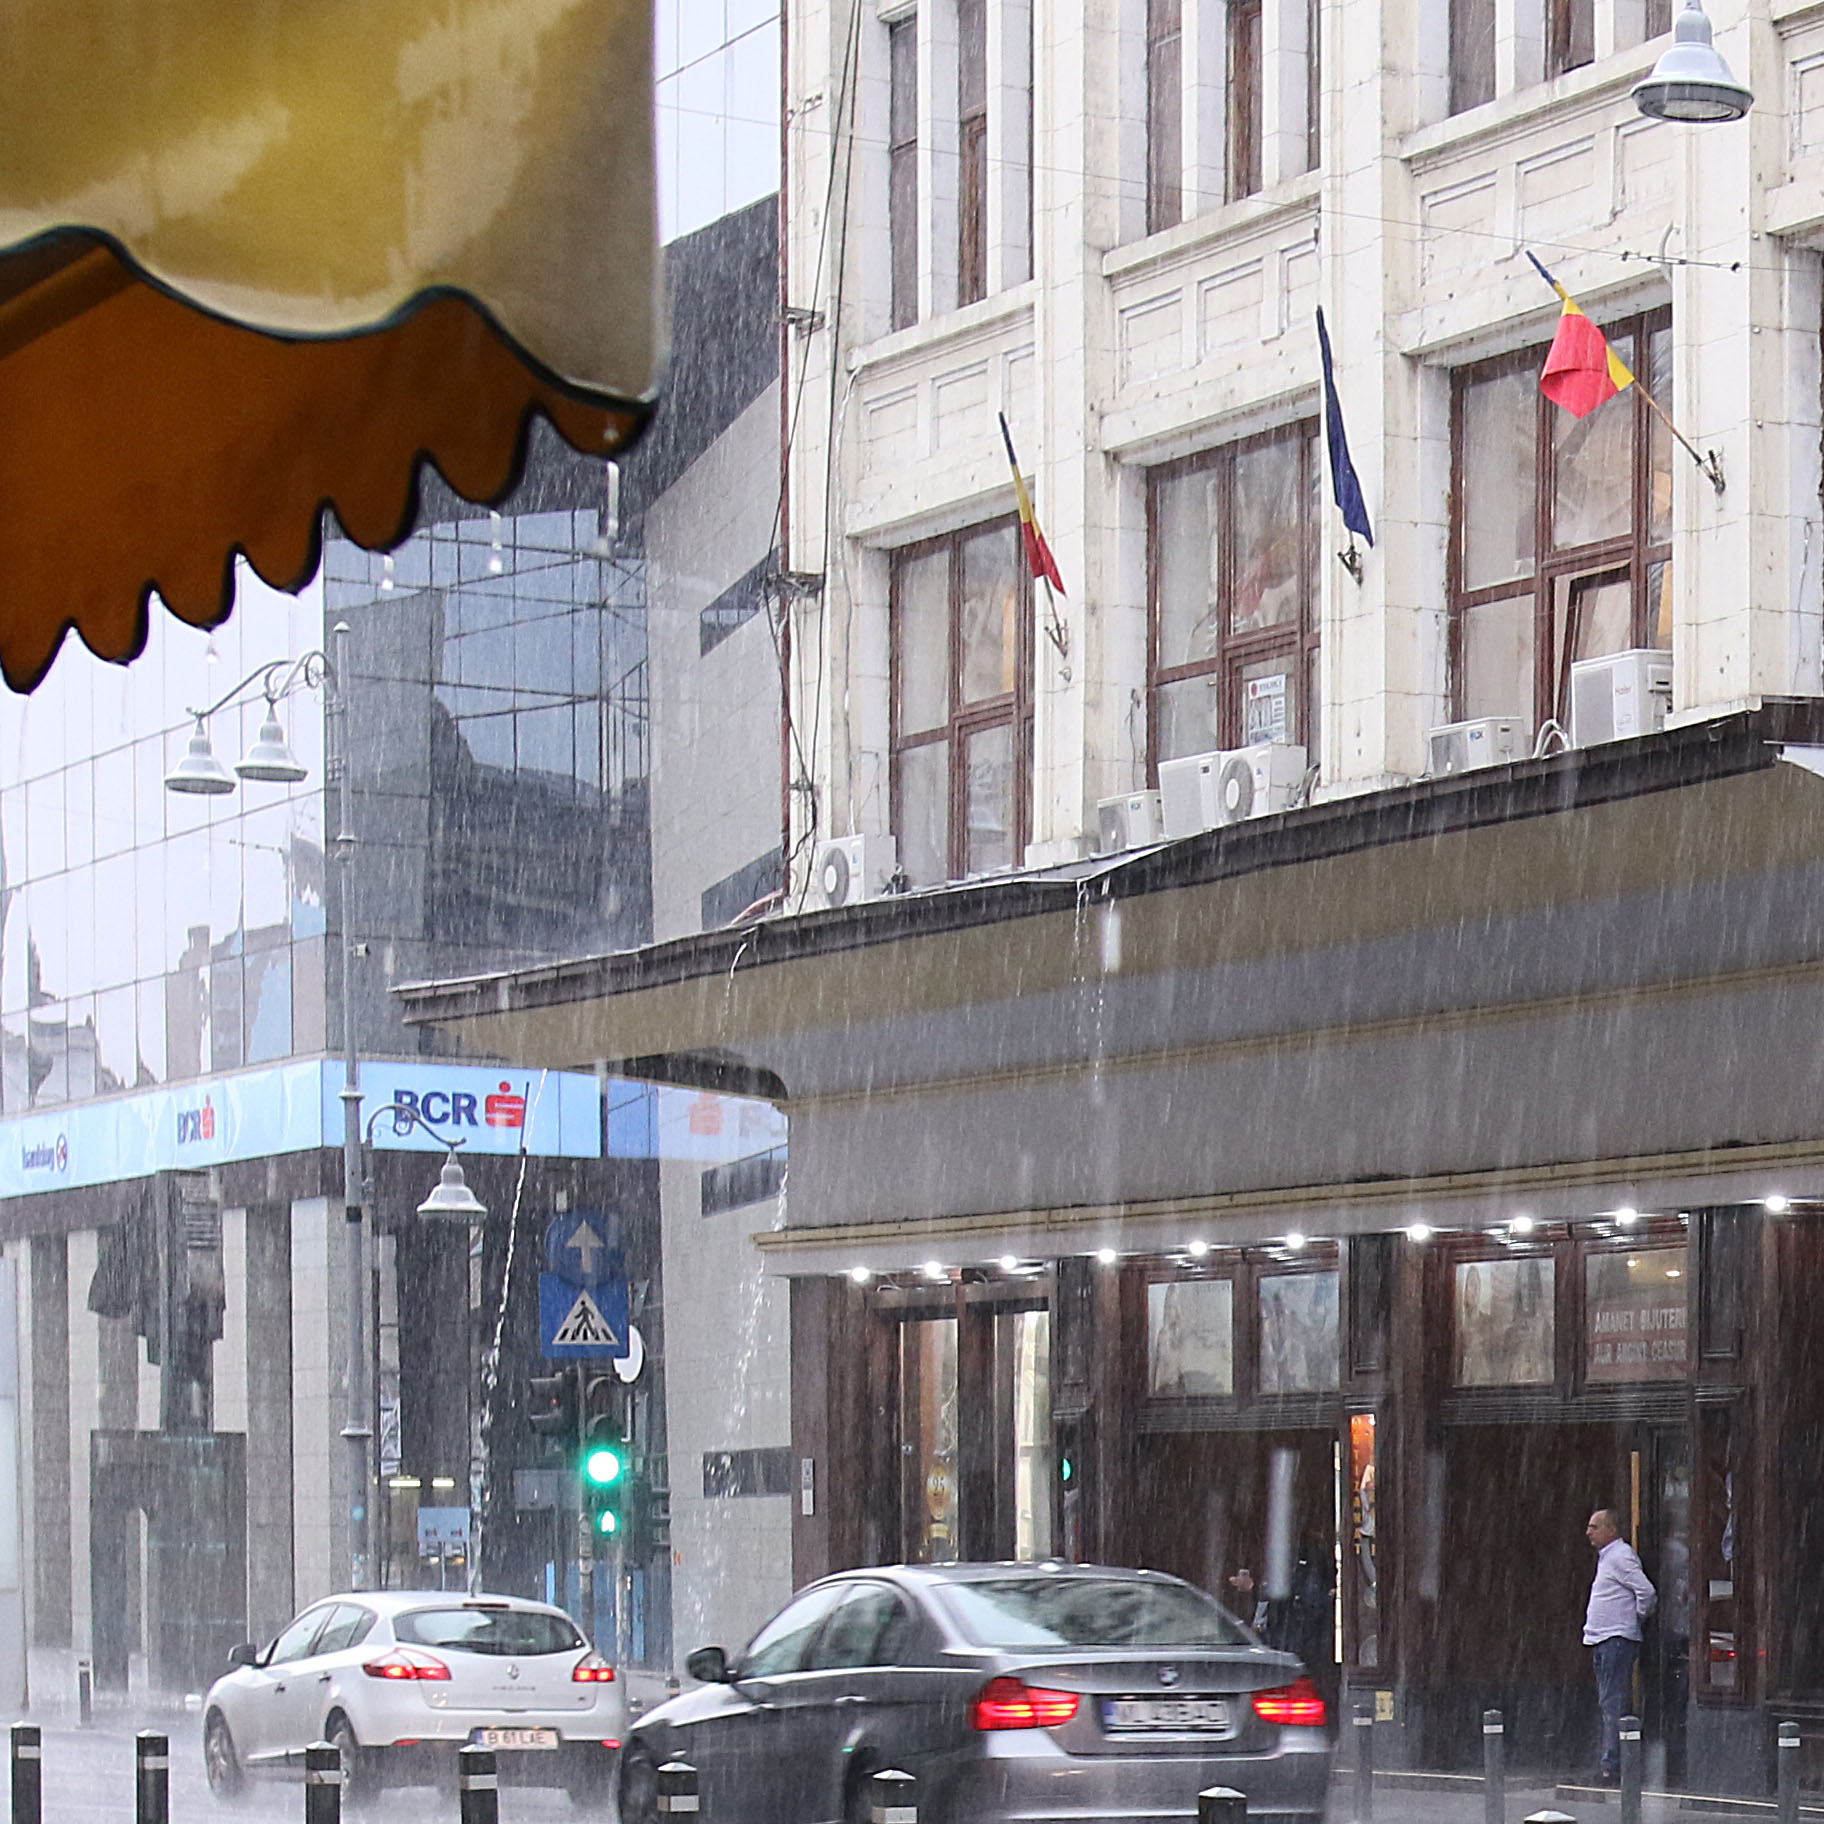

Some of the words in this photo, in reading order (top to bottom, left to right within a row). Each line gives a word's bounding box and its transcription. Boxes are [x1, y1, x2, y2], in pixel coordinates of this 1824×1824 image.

[394, 1089, 478, 1126] BCR
[1594, 1310, 1635, 1334] AMANET
[487, 1731, 498, 1745] B
